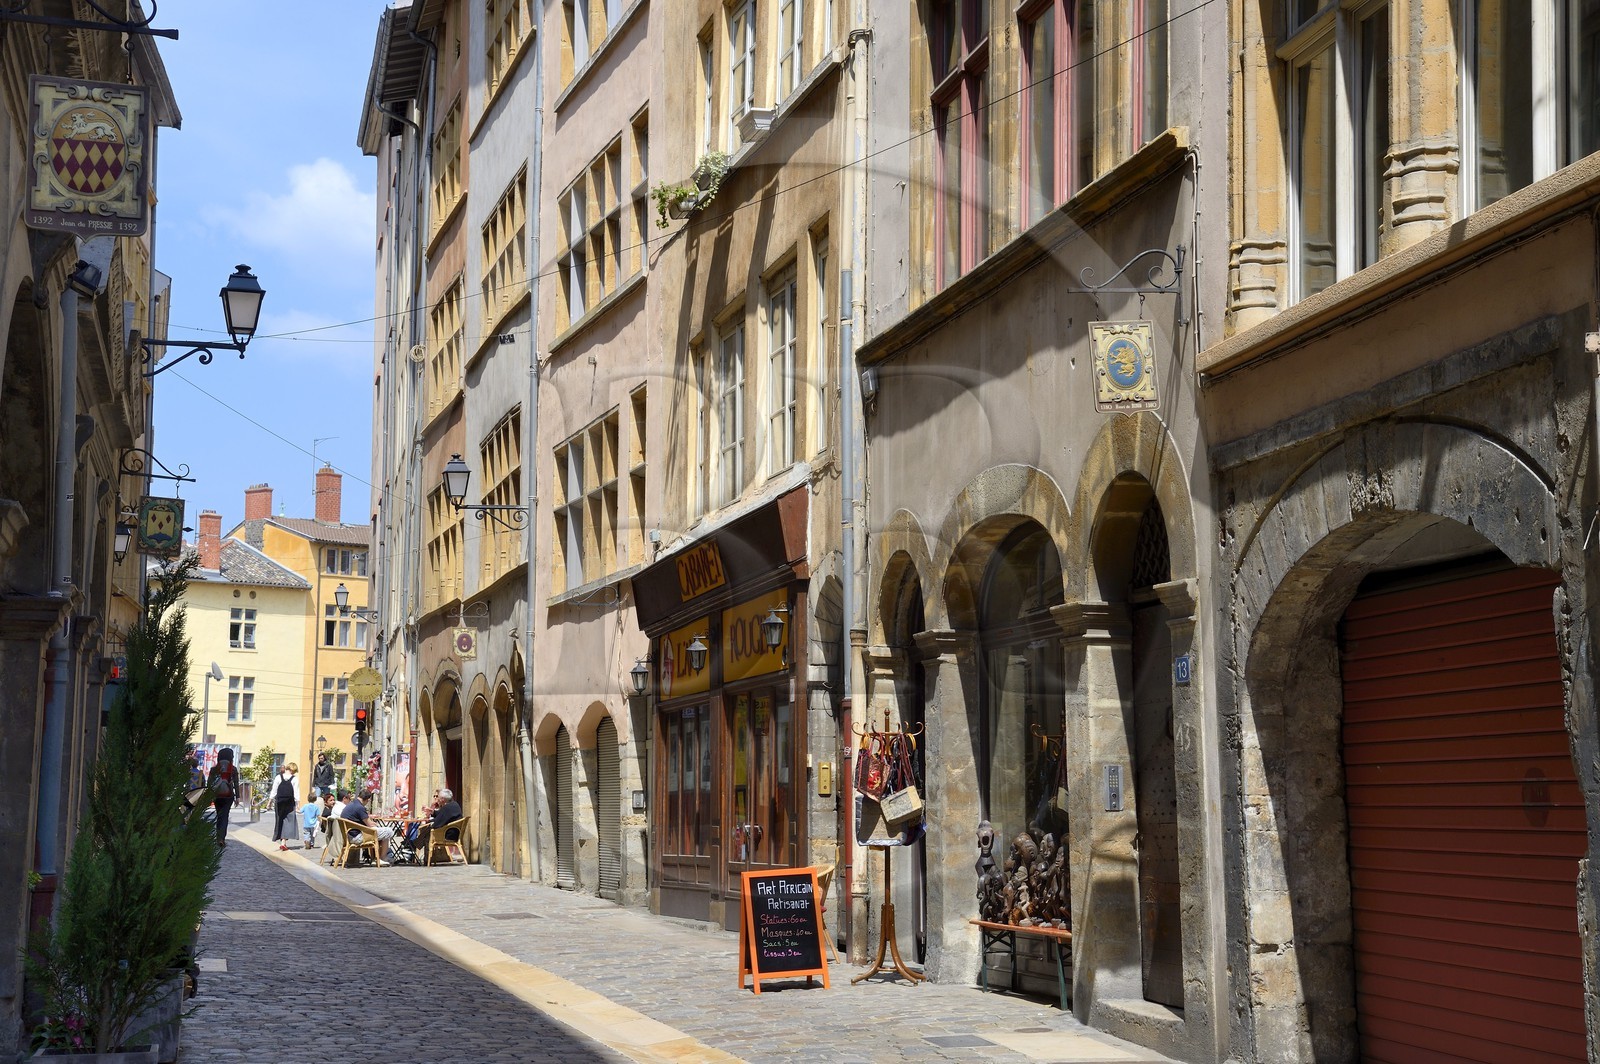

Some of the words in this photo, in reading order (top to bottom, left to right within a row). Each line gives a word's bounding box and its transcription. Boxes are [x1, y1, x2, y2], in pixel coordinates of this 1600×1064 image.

[33, 215, 53, 225] 1392
[119, 222, 138, 232] 1392
[677, 541, 722, 597] CABARET
[1177, 661, 1187, 679] 13
